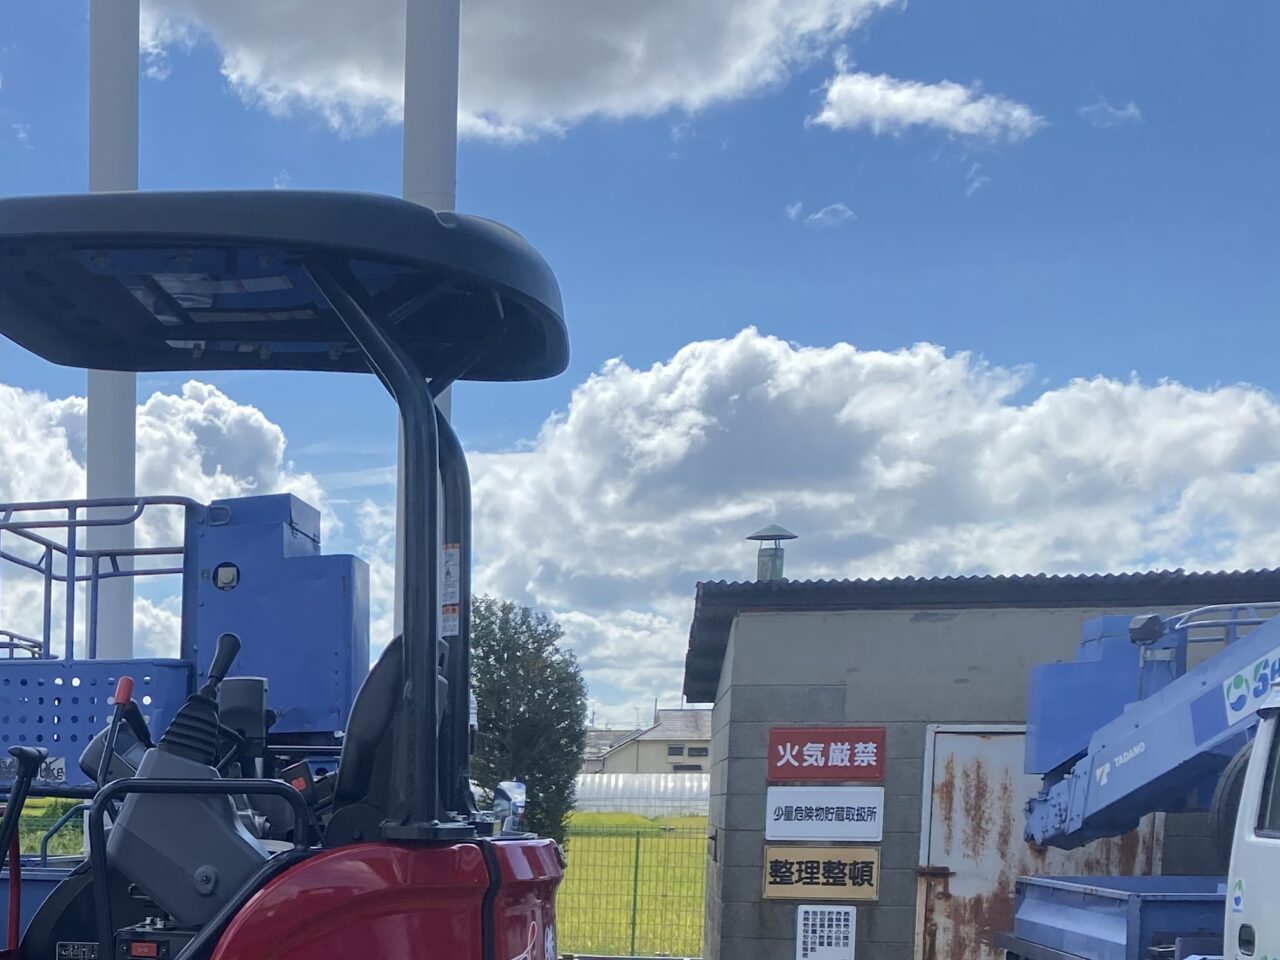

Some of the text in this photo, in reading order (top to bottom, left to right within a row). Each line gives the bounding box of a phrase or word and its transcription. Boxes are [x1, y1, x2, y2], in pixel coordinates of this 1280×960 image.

[776, 742, 878, 767] 火気厳禁
[1114, 742, 1145, 768] TADANO
[773, 805, 878, 823] 少量危険物貯蔵取扱所
[769, 859, 875, 887] 整理整頓
